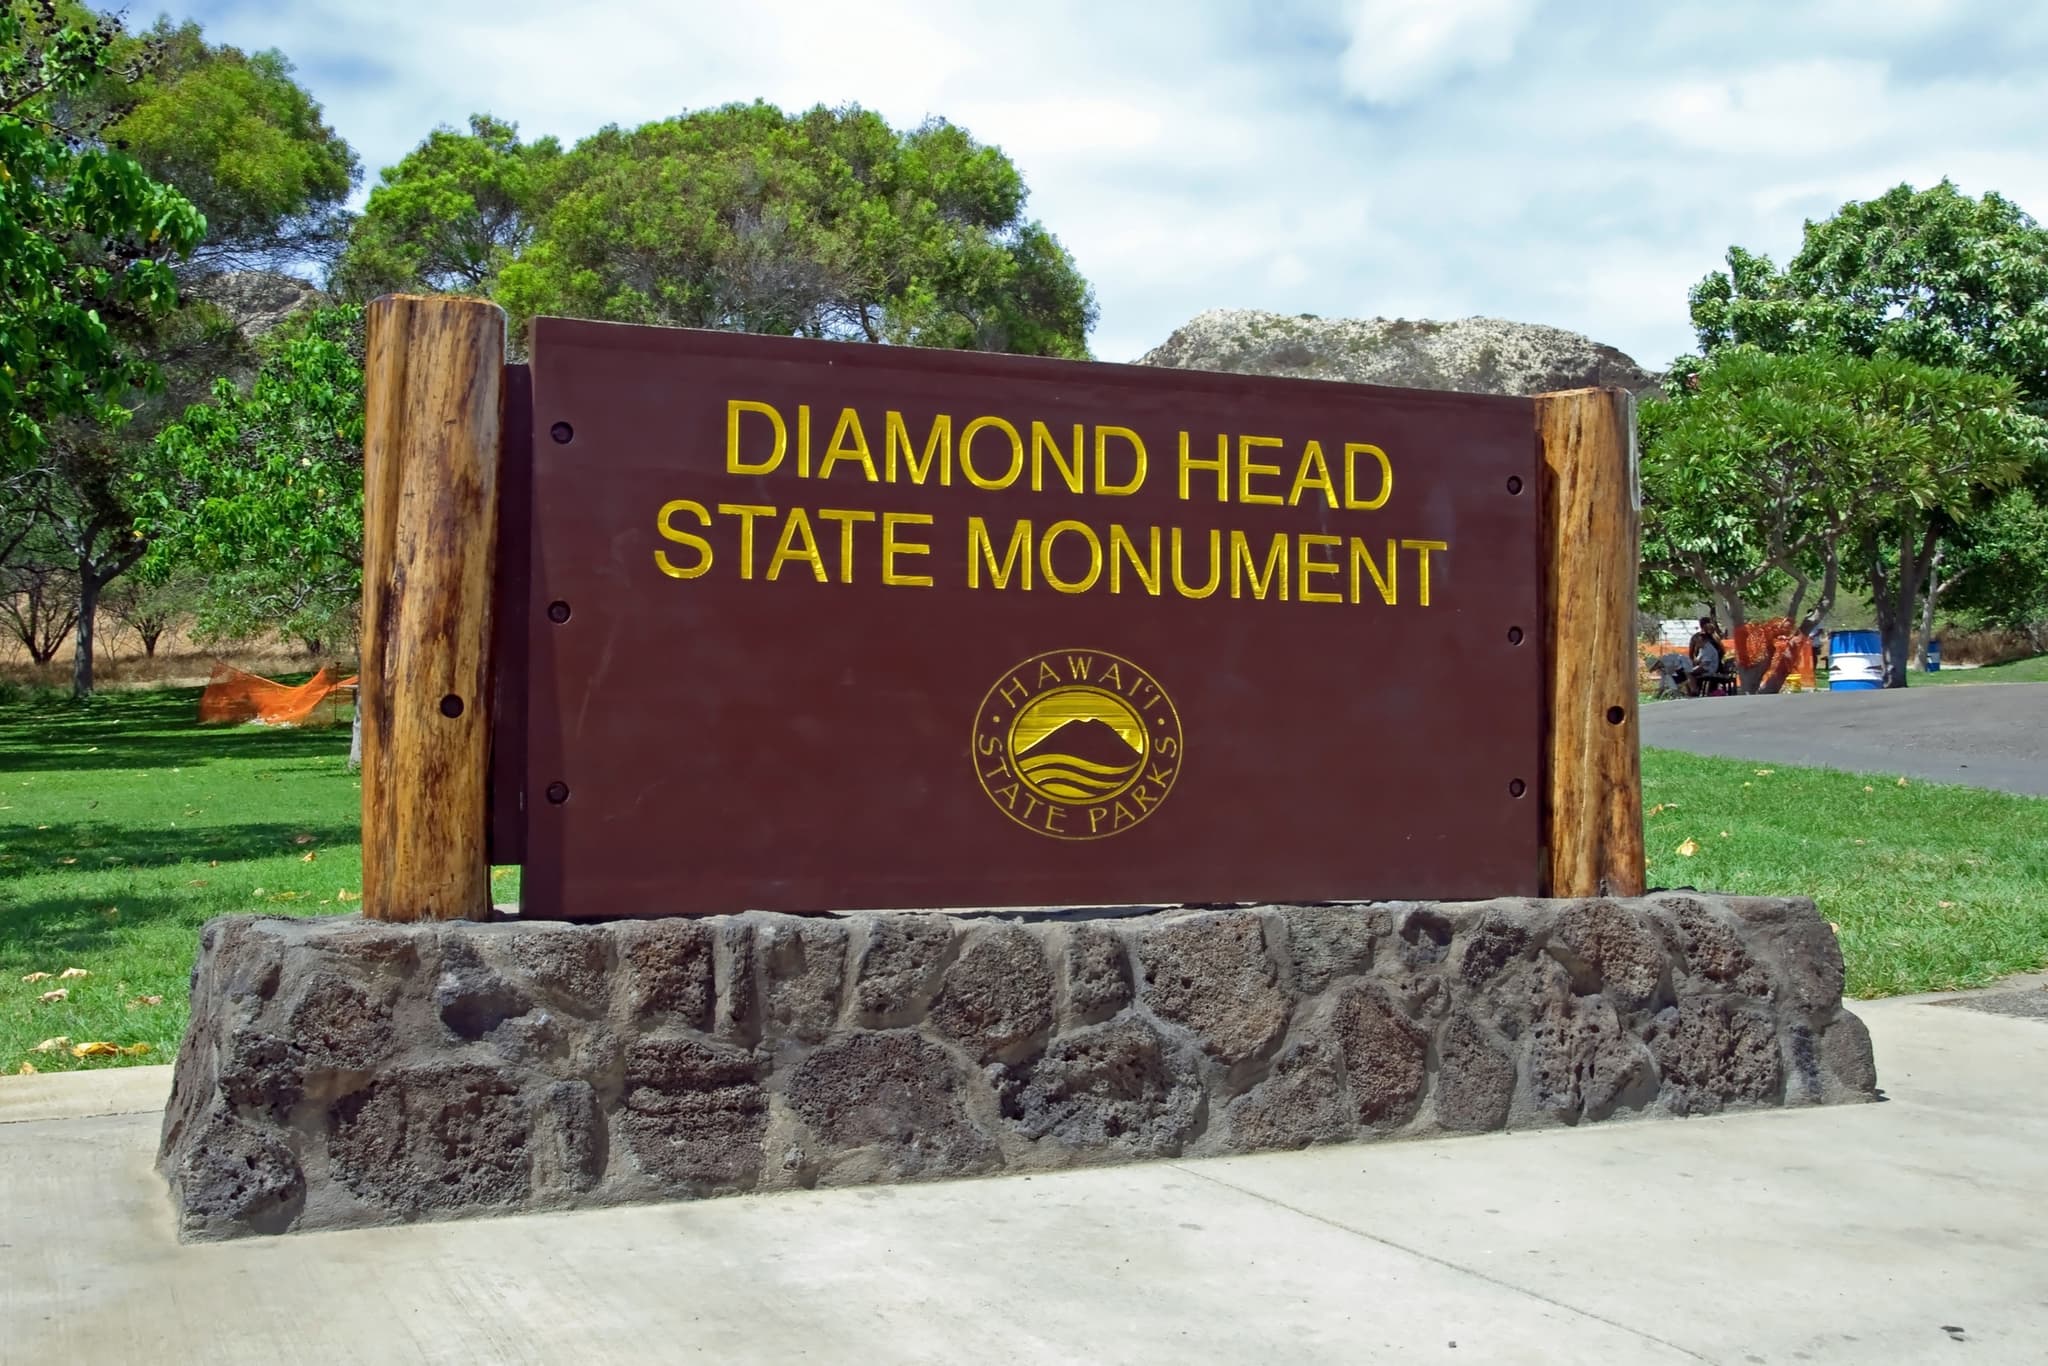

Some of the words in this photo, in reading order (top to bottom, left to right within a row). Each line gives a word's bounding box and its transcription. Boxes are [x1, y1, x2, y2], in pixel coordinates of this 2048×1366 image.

[727, 400, 1147, 497] DIAMOND
[1179, 431, 1392, 511] HEAD
[655, 500, 933, 588] STATE
[968, 517, 1447, 607] MONUMENT
[979, 734, 1067, 833] STATE
[1089, 736, 1176, 833] PARKS
